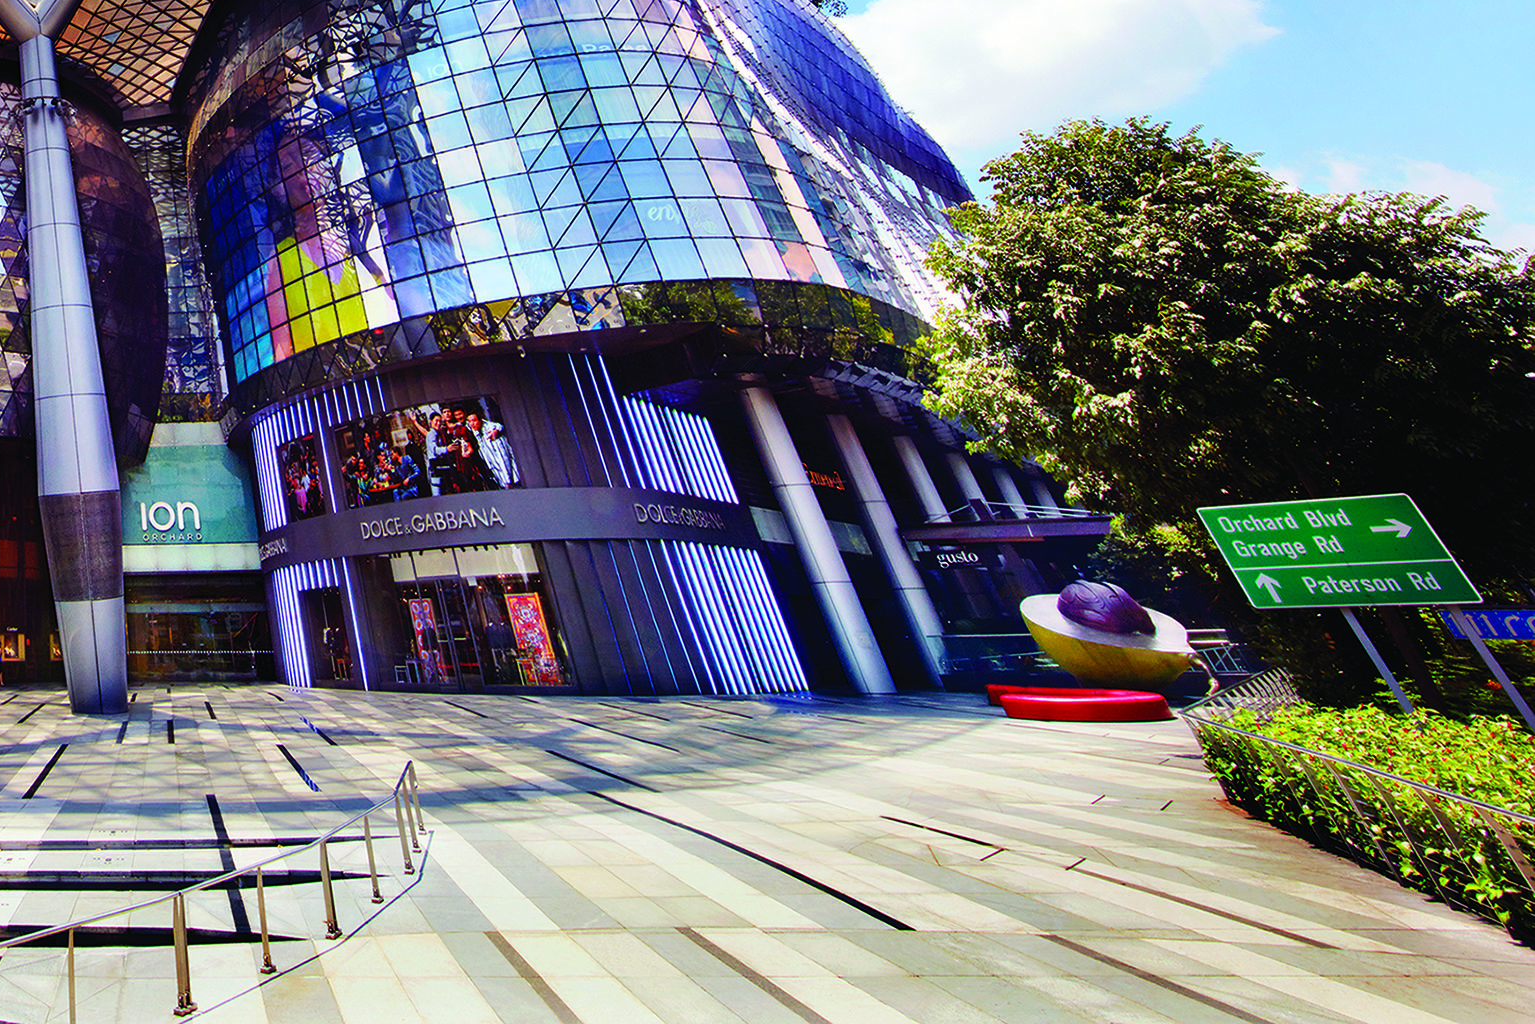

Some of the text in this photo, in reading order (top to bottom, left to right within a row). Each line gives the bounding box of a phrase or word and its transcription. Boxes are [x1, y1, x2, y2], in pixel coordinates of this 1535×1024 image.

[360, 506, 505, 540] DOLCE & GABBANA
[633, 503, 679, 524] DOLCE
[1217, 508, 1352, 533] Orchard Blvd
[143, 533, 202, 542] ORCHARD
[1232, 535, 1345, 559] Grange Rd
[936, 551, 979, 569] gusto
[1301, 571, 1442, 594] Paterson Rd
